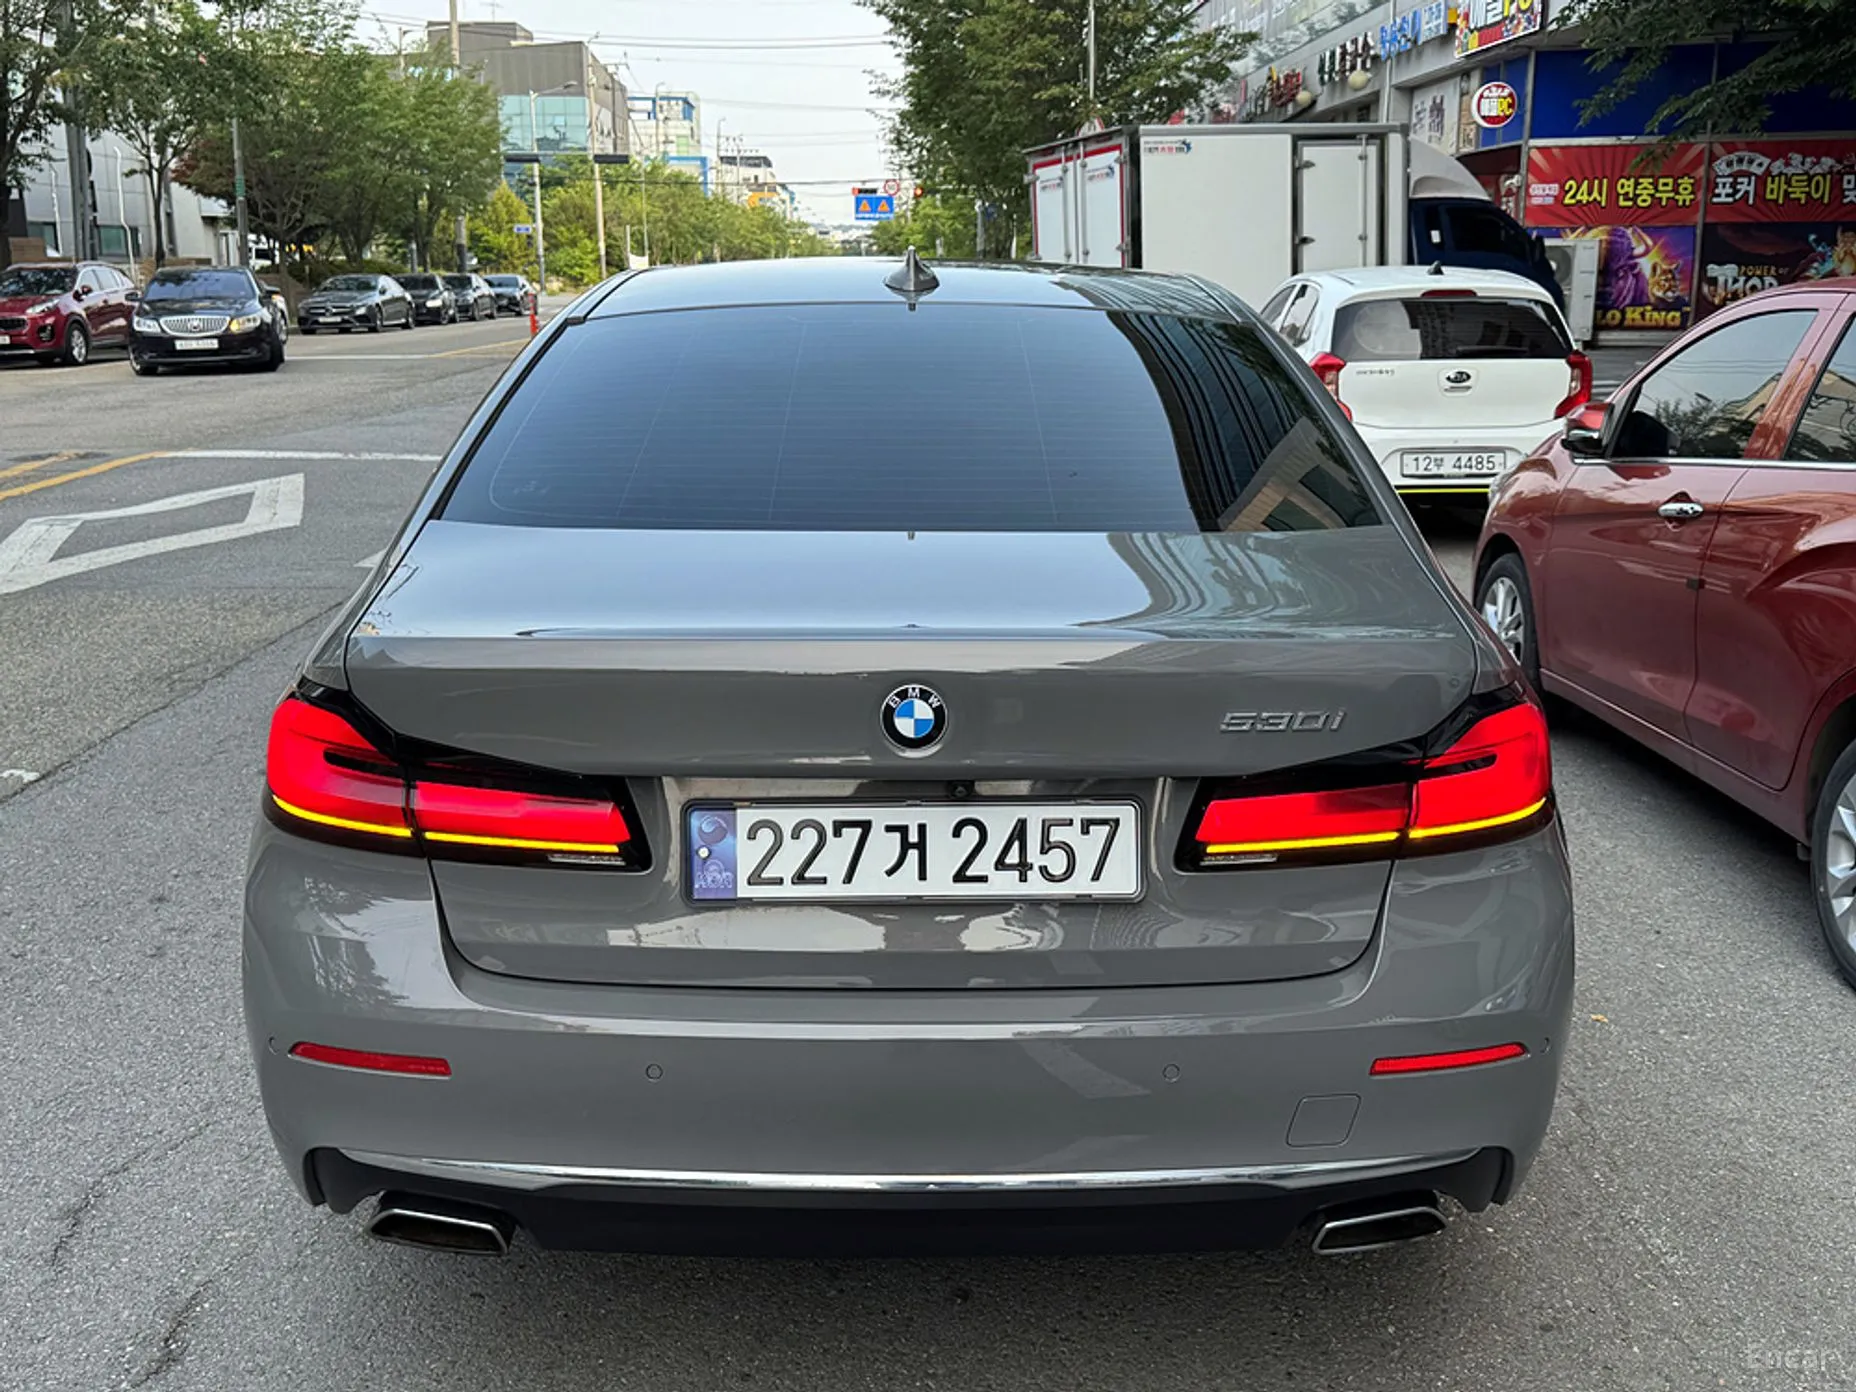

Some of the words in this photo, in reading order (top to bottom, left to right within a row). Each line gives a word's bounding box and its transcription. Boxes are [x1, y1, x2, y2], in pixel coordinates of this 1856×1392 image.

[1563, 178, 1609, 208] 24시
[1616, 176, 1695, 208] 연중무휴
[1712, 175, 1756, 205] 포커
[1765, 174, 1832, 205] 바둑이
[1741, 265, 1777, 276] POWER
[1452, 454, 1496, 471] 4485
[888, 687, 941, 709] BMW
[1220, 706, 1346, 731] 530i
[746, 818, 927, 886] 227거
[952, 816, 1121, 884] 2457
